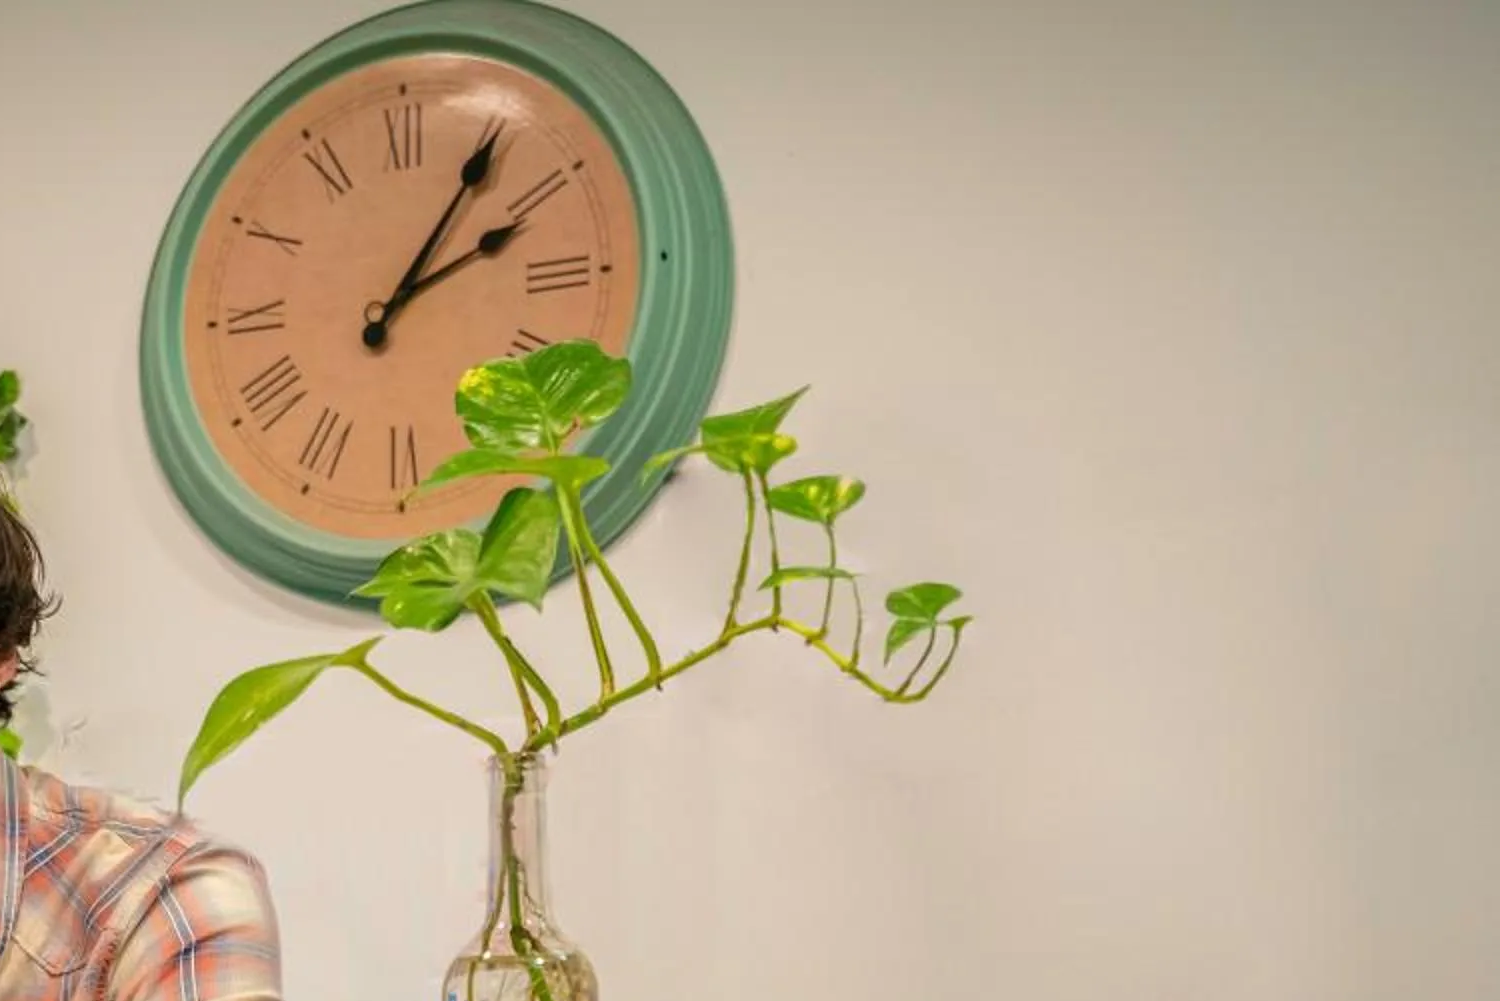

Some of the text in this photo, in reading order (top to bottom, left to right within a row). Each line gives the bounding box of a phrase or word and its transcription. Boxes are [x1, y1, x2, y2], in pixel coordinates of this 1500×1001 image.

[382, 102, 422, 173] XII
[507, 169, 569, 221] II
[246, 221, 303, 256] X
[526, 256, 590, 294] III
